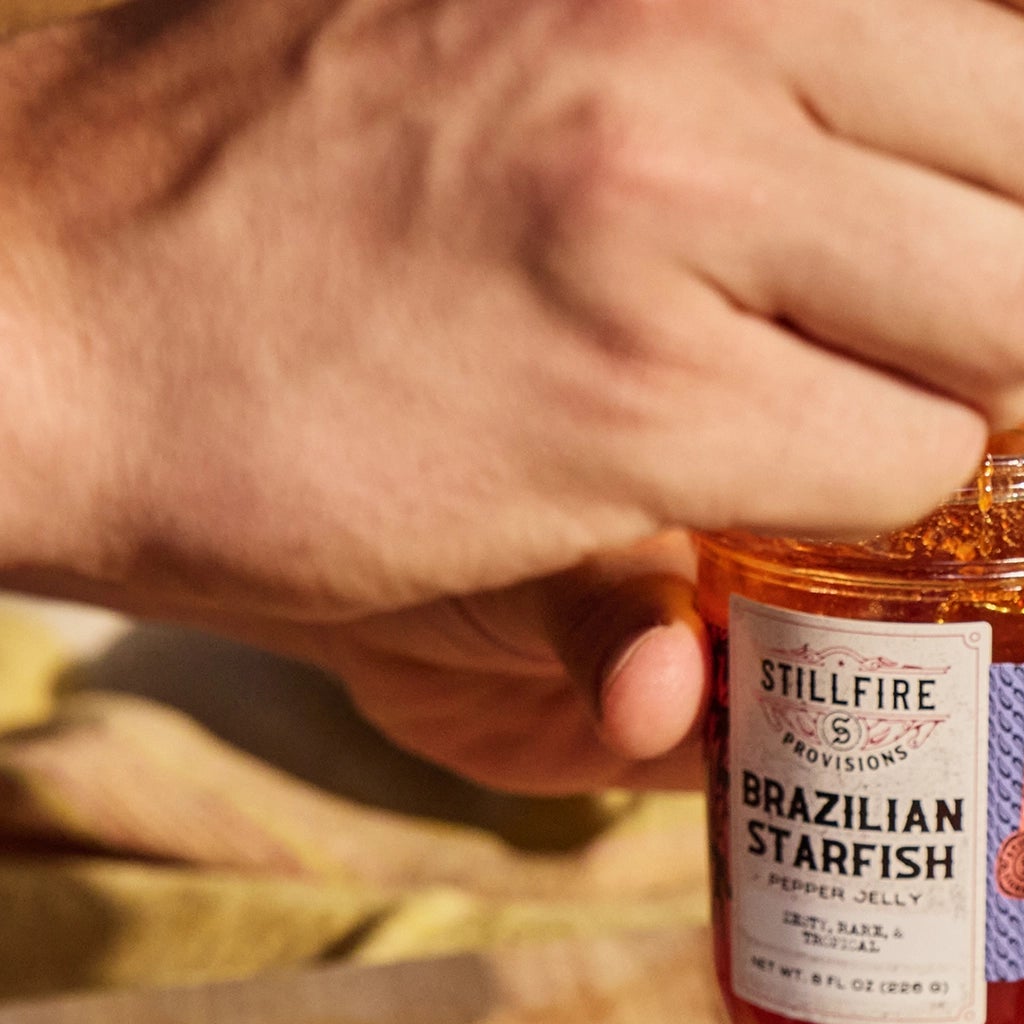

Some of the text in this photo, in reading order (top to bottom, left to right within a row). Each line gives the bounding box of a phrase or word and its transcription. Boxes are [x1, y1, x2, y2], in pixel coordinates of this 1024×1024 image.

[760, 659, 936, 711] STILLFIRE
[782, 732, 909, 772] PROVISIONS
[742, 769, 964, 833] BRAZILIAN
[747, 820, 955, 880] STARFISH
[768, 872, 922, 906] PEPPER JELLY
[751, 955, 775, 972] NET
[826, 976, 846, 990] FL
[853, 979, 874, 992] OZ
